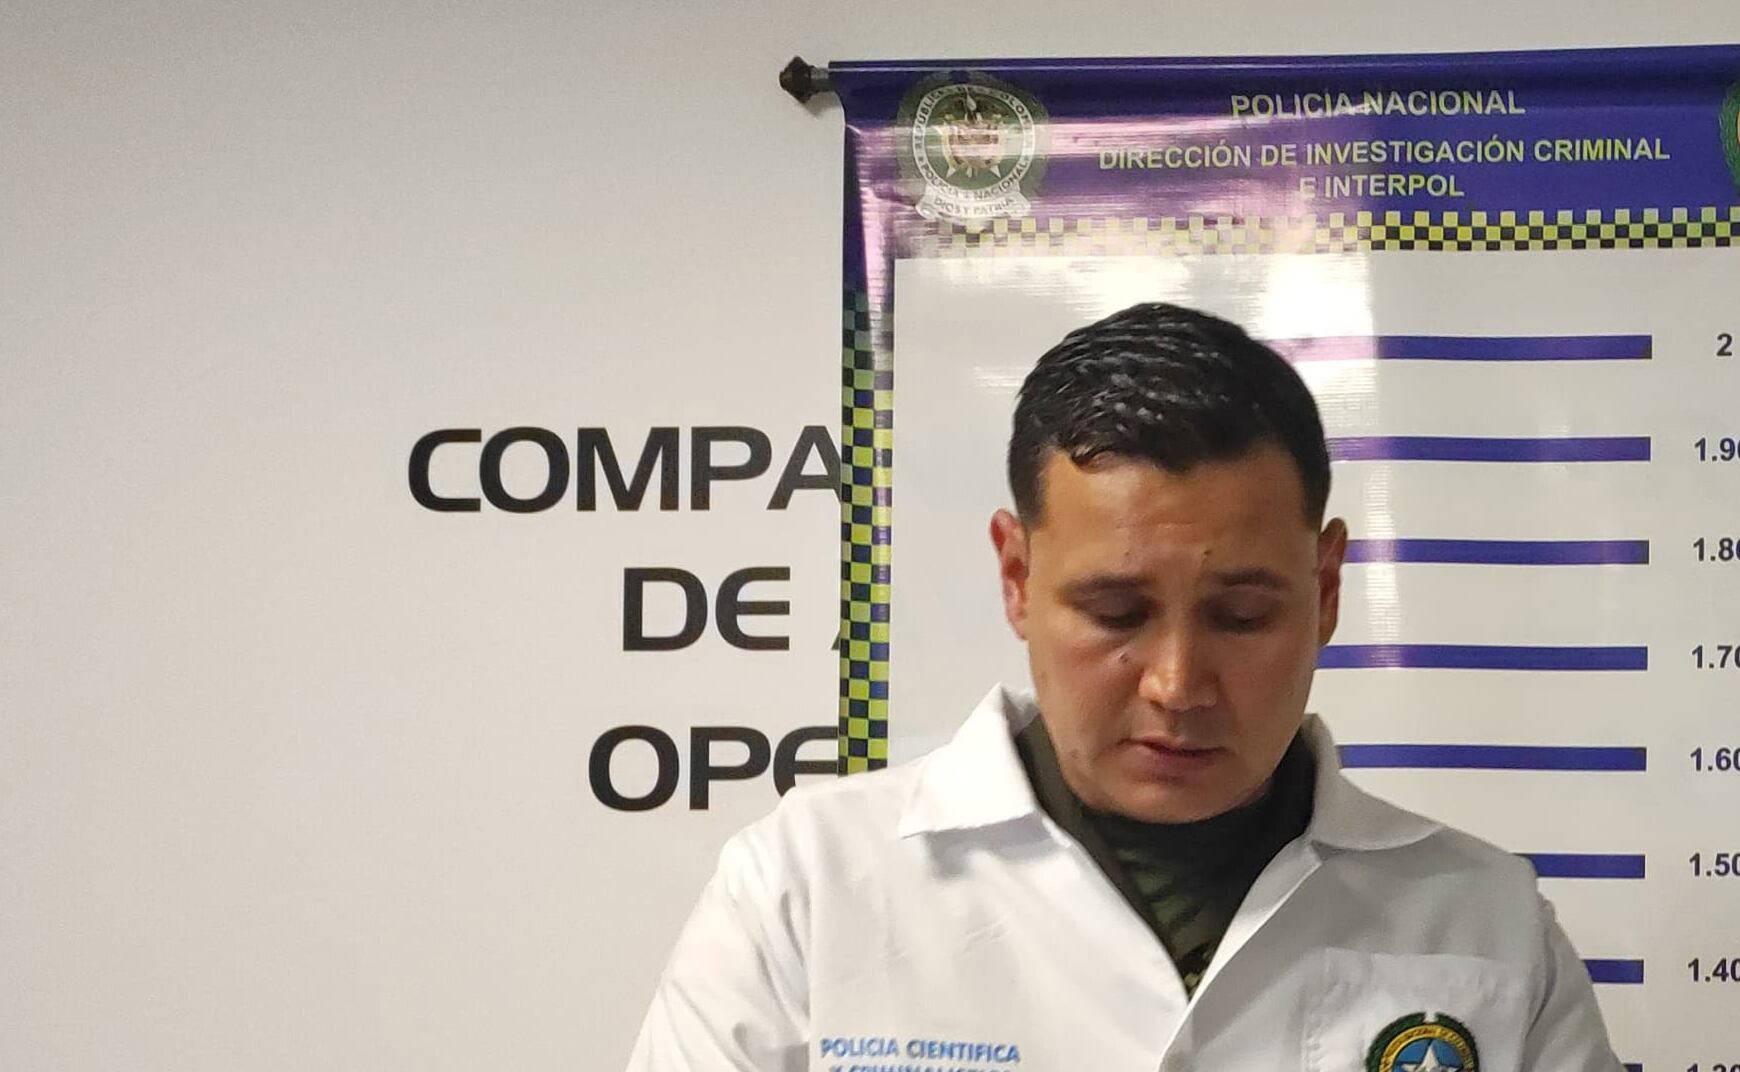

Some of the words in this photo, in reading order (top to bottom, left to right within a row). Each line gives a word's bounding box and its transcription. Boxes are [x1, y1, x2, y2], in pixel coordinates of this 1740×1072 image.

[1362, 89, 1526, 116] NACIONAL
[1099, 139, 1251, 170] DIRECCIÓN
[1260, 144, 1297, 166] DE
[1306, 134, 1525, 165] INVESTIGACIÓN
[1533, 138, 1671, 161] CRIMINAL
[1301, 177, 1316, 198] E
[1325, 174, 1465, 197] INTERPOL
[1716, 331, 1733, 357] 2
[407, 425, 841, 513] COMPA
[622, 566, 791, 652] DE
[820, 1037, 899, 1058] POLICIA
[906, 1039, 1021, 1062] CIENTIFICA
